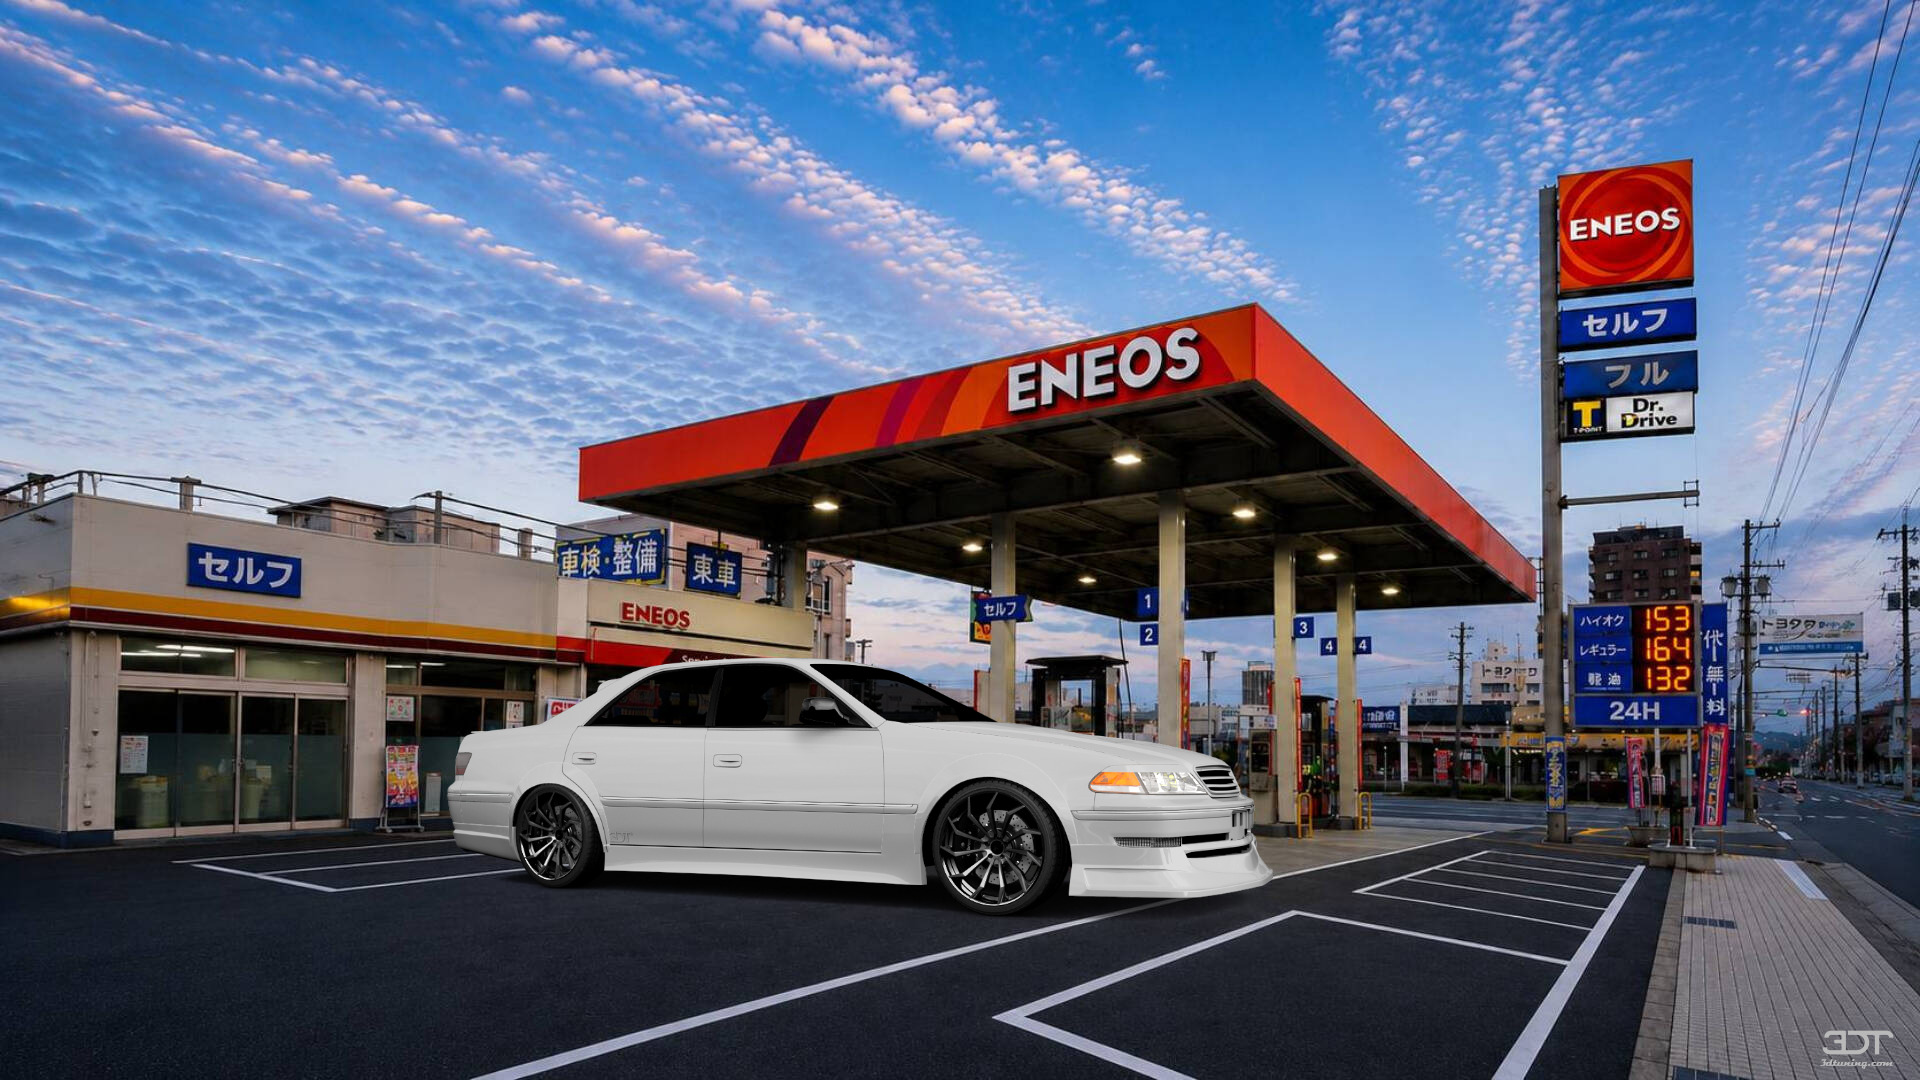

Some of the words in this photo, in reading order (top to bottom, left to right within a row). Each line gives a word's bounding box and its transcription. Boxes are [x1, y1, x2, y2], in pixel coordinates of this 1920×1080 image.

[1570, 207, 1681, 241] ENEOS
[1583, 308, 1668, 338] セルフ
[1007, 327, 1200, 412] ENEOS
[1605, 361, 1669, 389] フル
[1573, 401, 1601, 428] T
[1633, 398, 1664, 413] Dr.
[1621, 413, 1678, 428] Drive
[198, 551, 293, 588] セルフ
[984, 602, 1016, 617] セルフ
[1144, 594, 1151, 609] 1
[622, 602, 691, 628] ENEOS
[1580, 614, 1625, 627] ハイオク
[1645, 605, 1690, 632] 153
[1145, 628, 1153, 642] 2
[1299, 621, 1308, 634] 3
[1325, 640, 1333, 653] 4
[1358, 639, 1367, 652] 4
[1579, 644, 1626, 657] レギュラー
[1645, 636, 1690, 662] 164
[1647, 666, 1691, 691] 132
[1610, 701, 1660, 721] 24H
